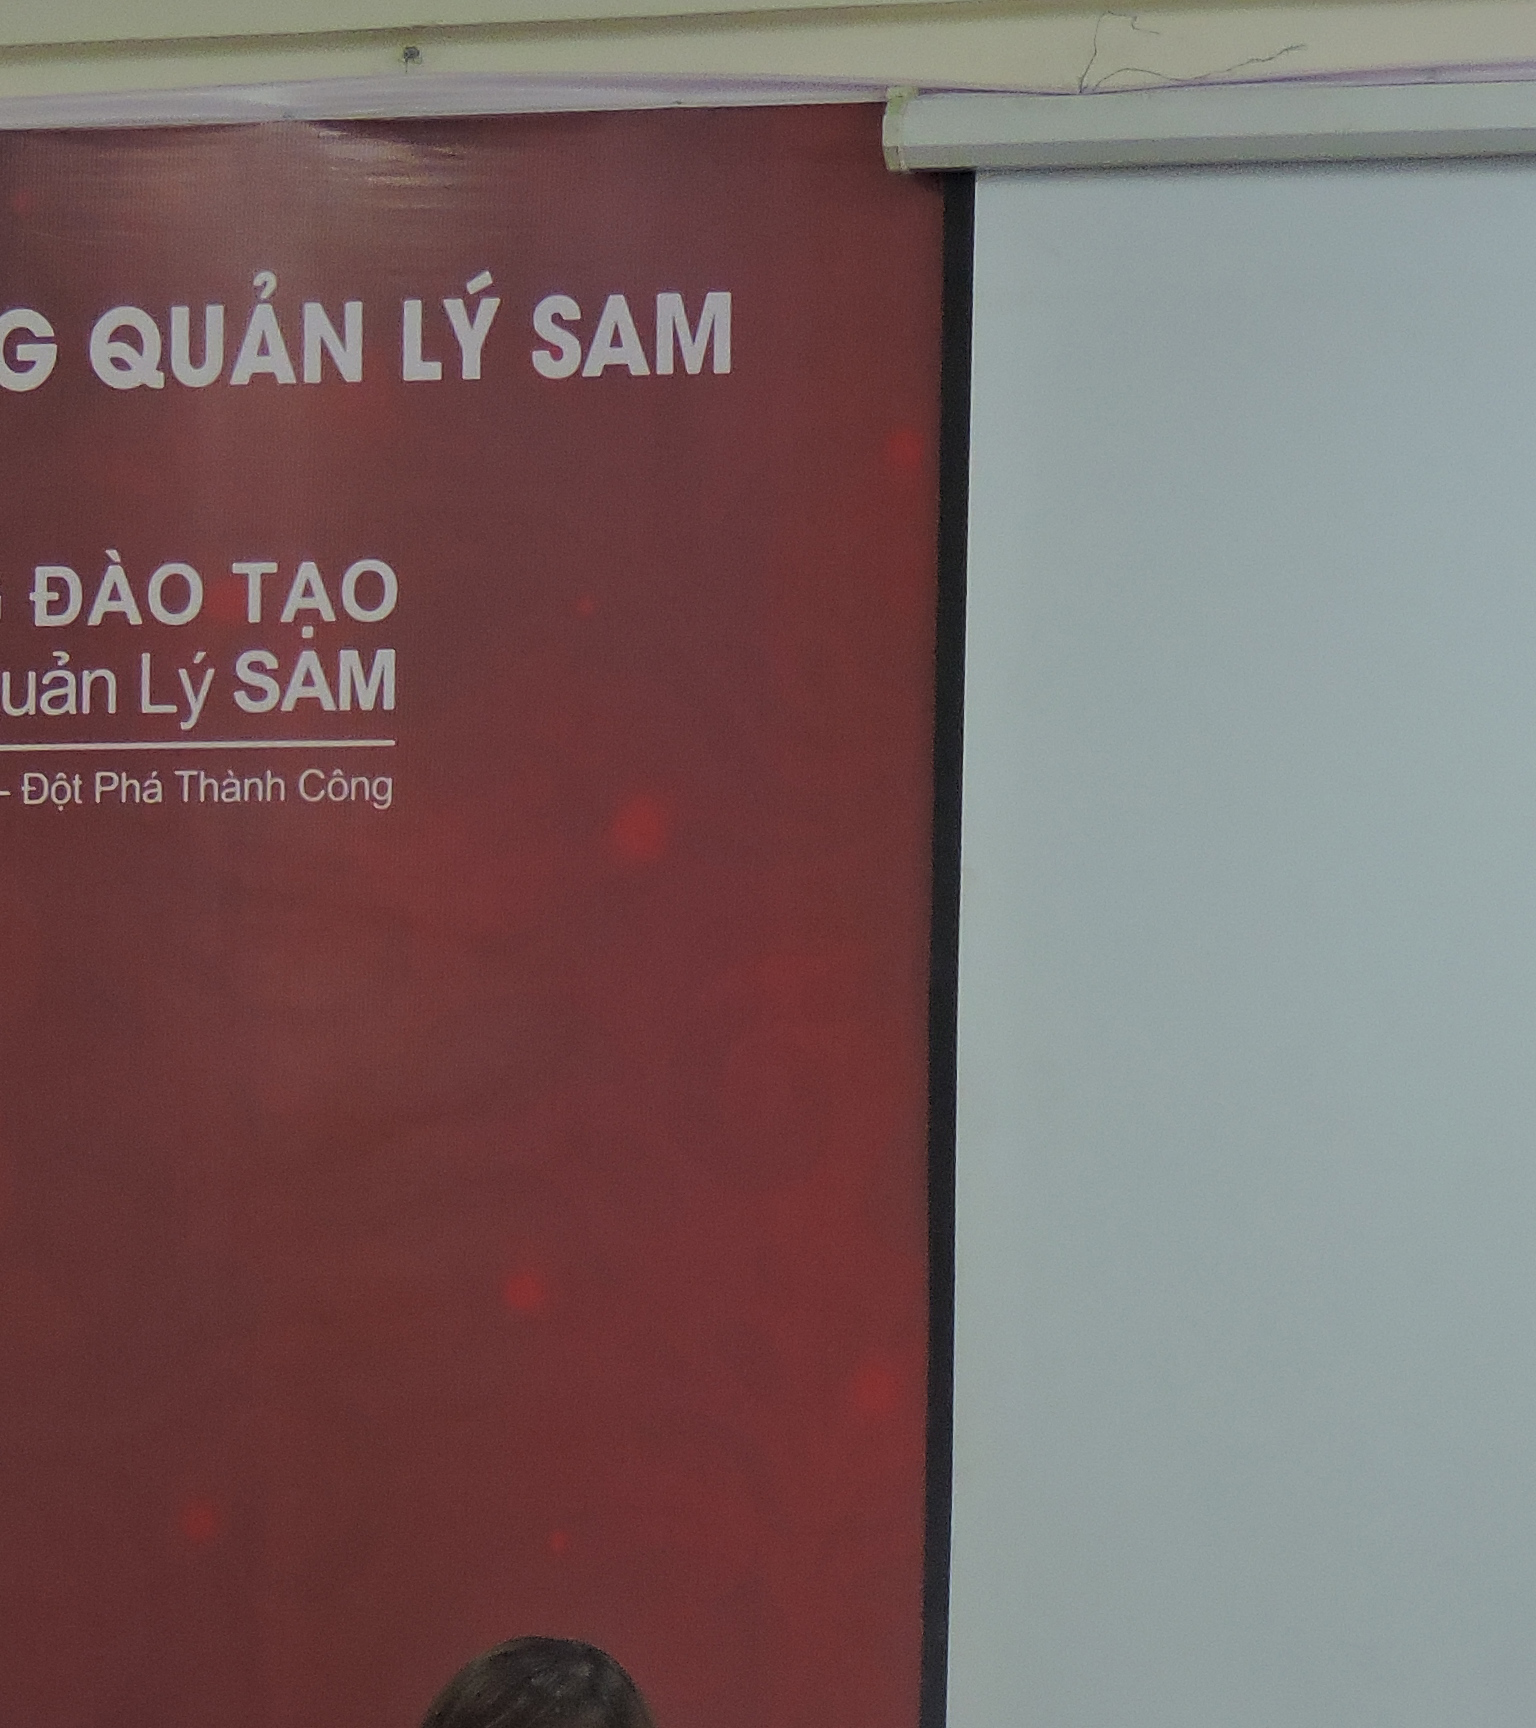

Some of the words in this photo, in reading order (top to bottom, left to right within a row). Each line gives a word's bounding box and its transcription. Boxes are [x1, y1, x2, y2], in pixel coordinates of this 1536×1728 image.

[89, 272, 363, 390] QUẢN
[402, 271, 501, 382] LÝ
[531, 291, 732, 380] SAM
[29, 549, 204, 627] ĐÀO
[232, 559, 398, 638] TẠO
[141, 651, 216, 731] Lý
[233, 648, 397, 713] SAM
[21, 767, 83, 811] Đột
[95, 771, 163, 804] Phá
[174, 768, 286, 803] Thành
[298, 766, 394, 811] Công
